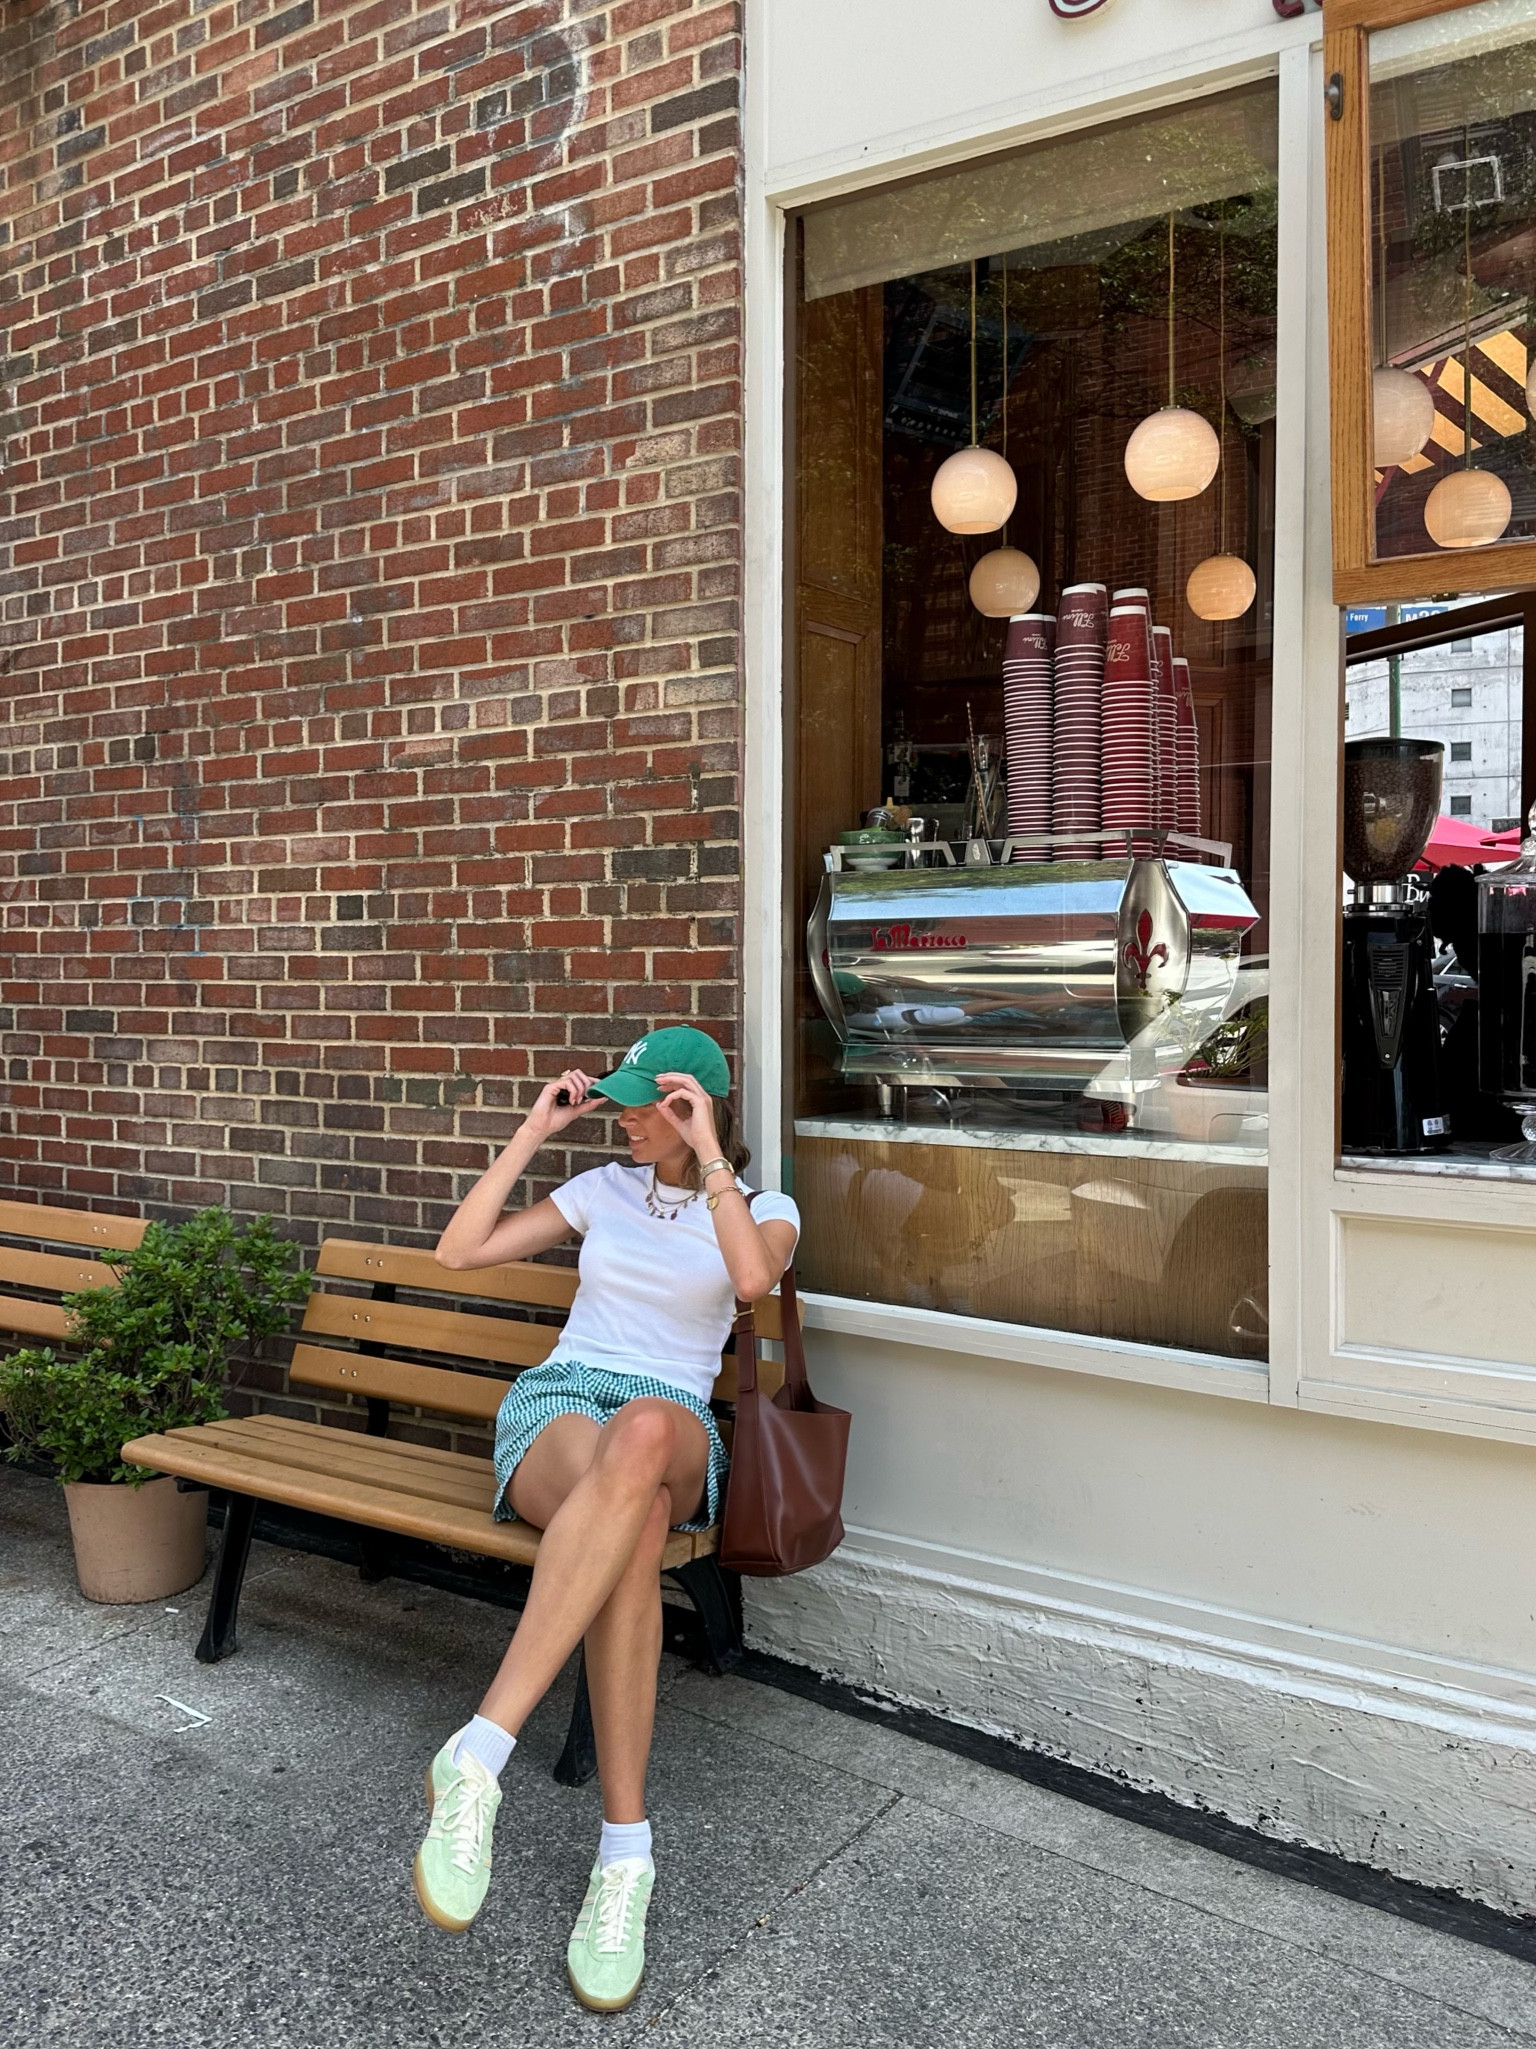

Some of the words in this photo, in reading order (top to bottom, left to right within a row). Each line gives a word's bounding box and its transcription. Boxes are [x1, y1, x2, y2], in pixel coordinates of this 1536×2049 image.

[1350, 614, 1369, 623] Ferry
[888, 923, 968, 948] Marzocco
[624, 1040, 648, 1065] NY
